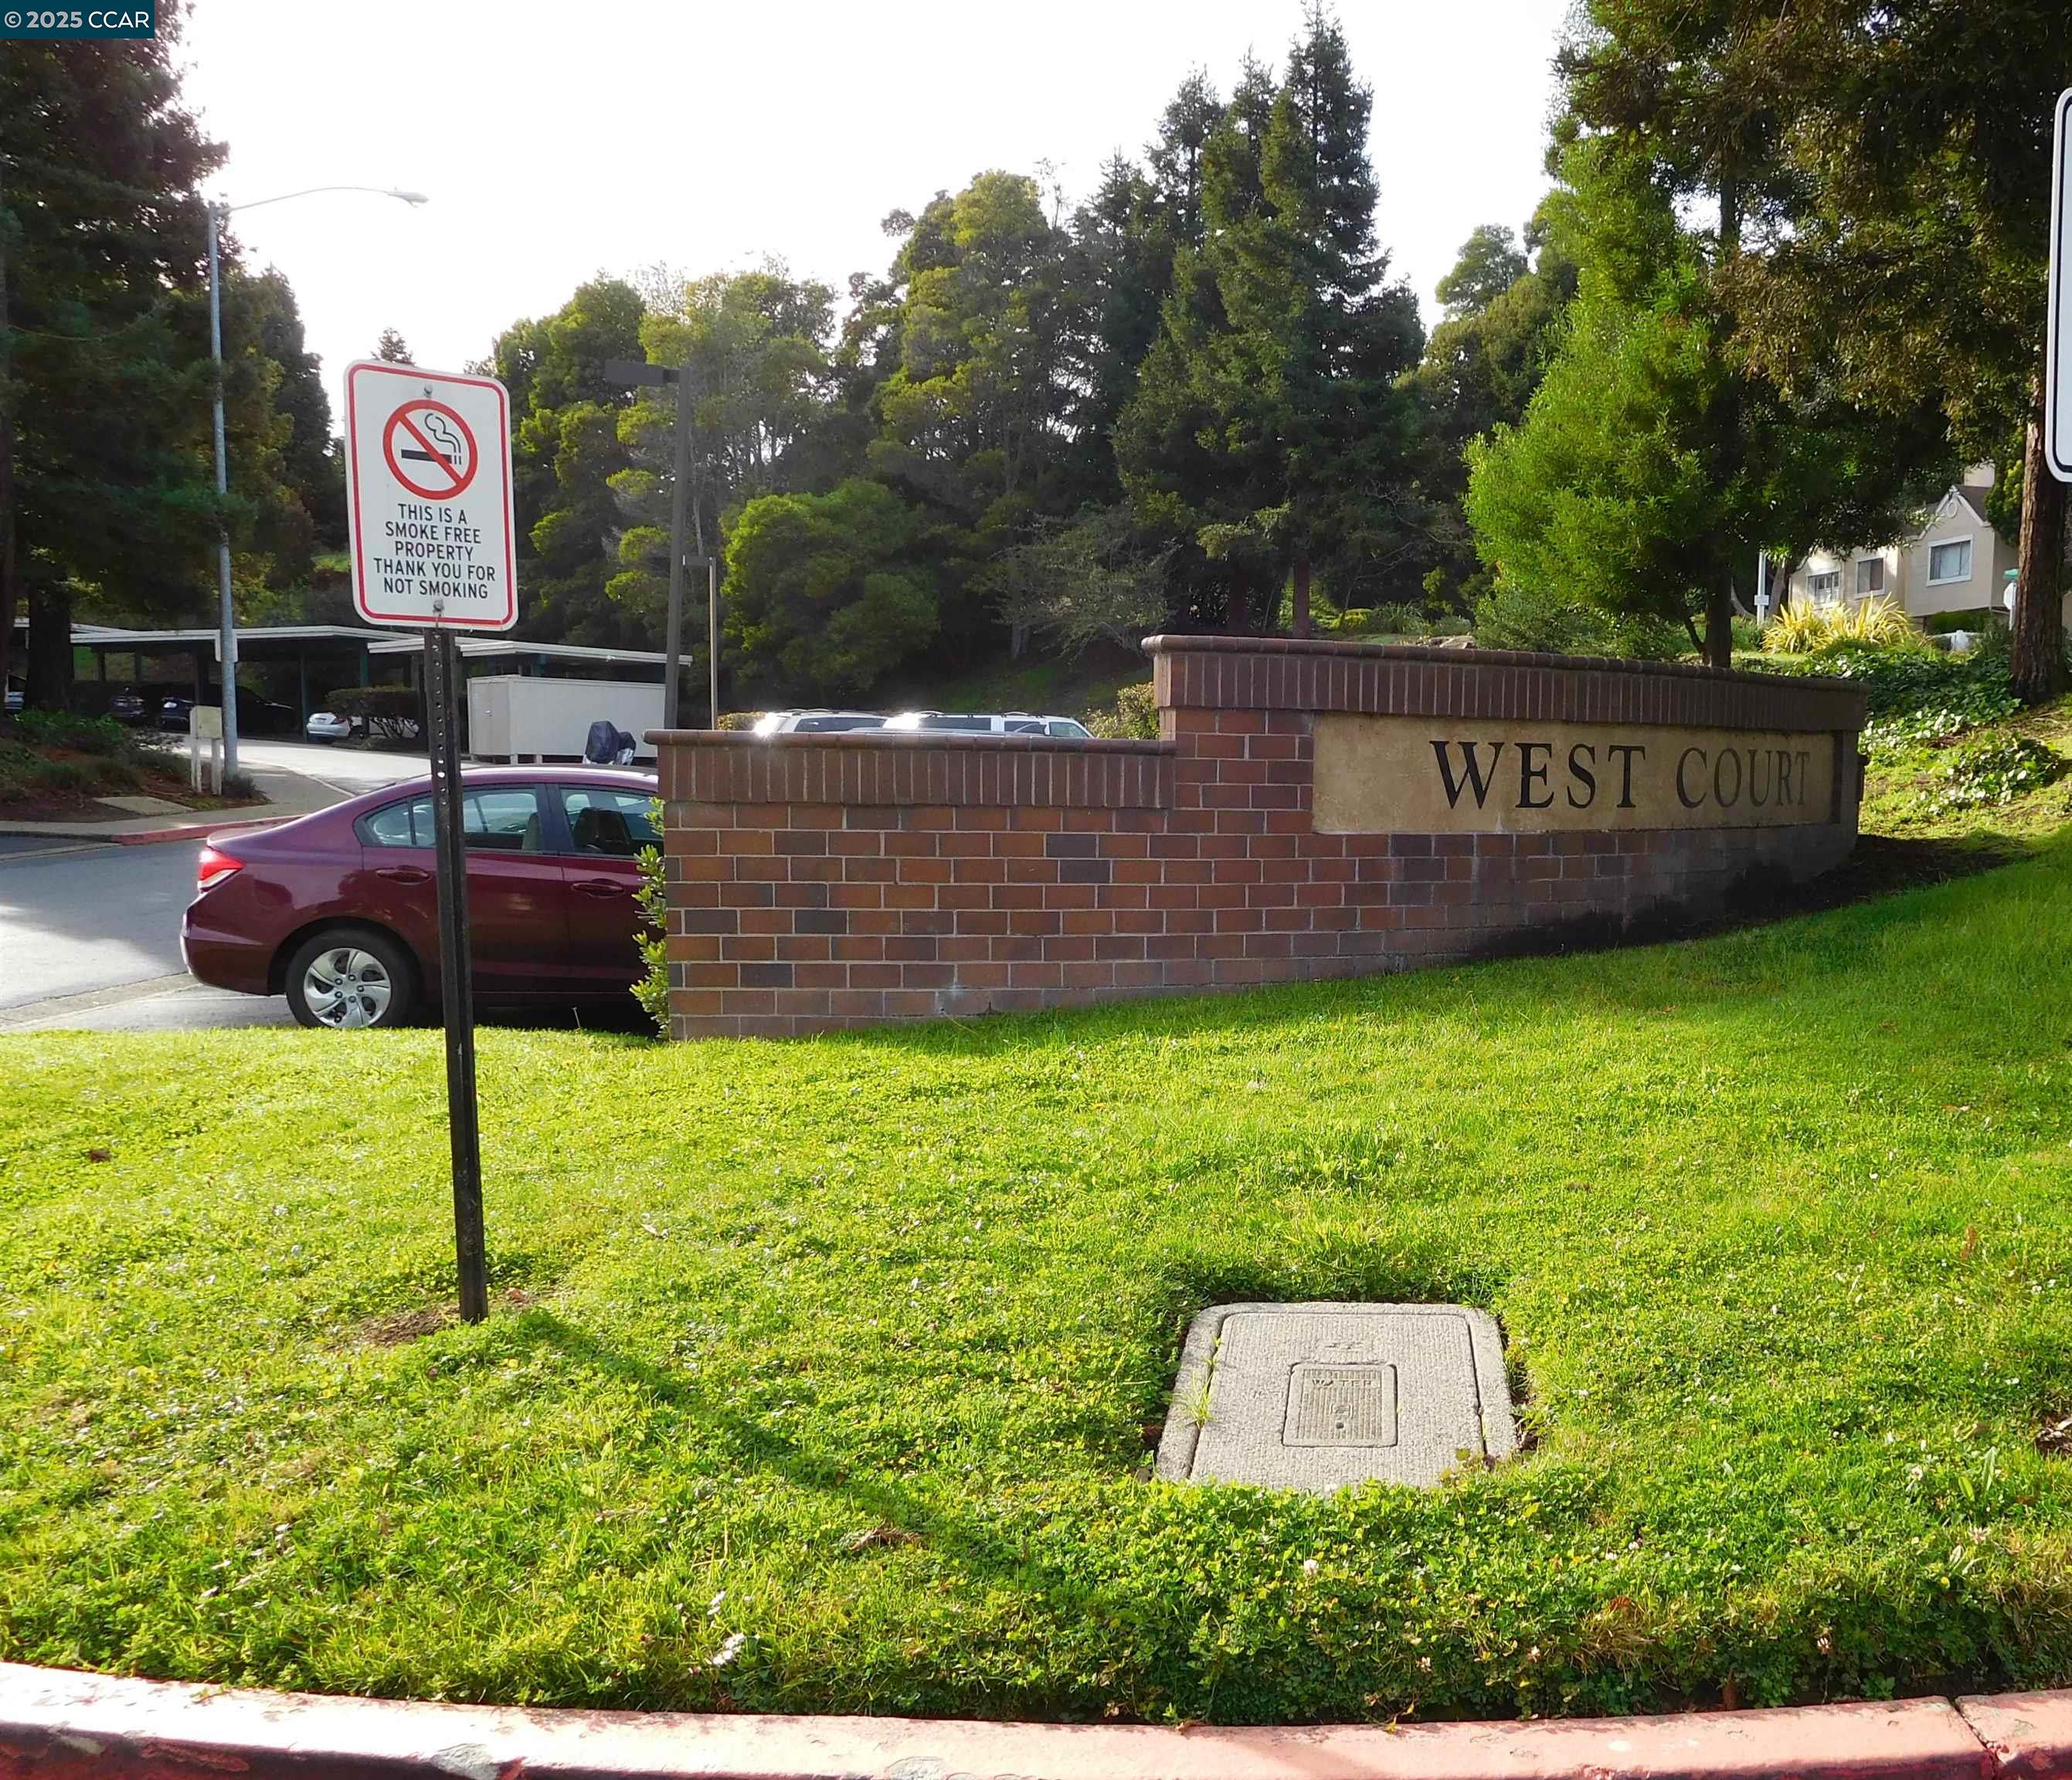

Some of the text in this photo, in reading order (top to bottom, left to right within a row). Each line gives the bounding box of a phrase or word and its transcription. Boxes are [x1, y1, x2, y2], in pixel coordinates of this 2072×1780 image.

[397, 503, 467, 525] THIS IS A
[385, 521, 481, 544] SMOKE FREE
[395, 541, 474, 562] PROPERTY
[373, 557, 496, 582] THANK YOU FOR
[384, 576, 488, 599] NOT SMOKING
[1428, 739, 1811, 810] WEST COURT
